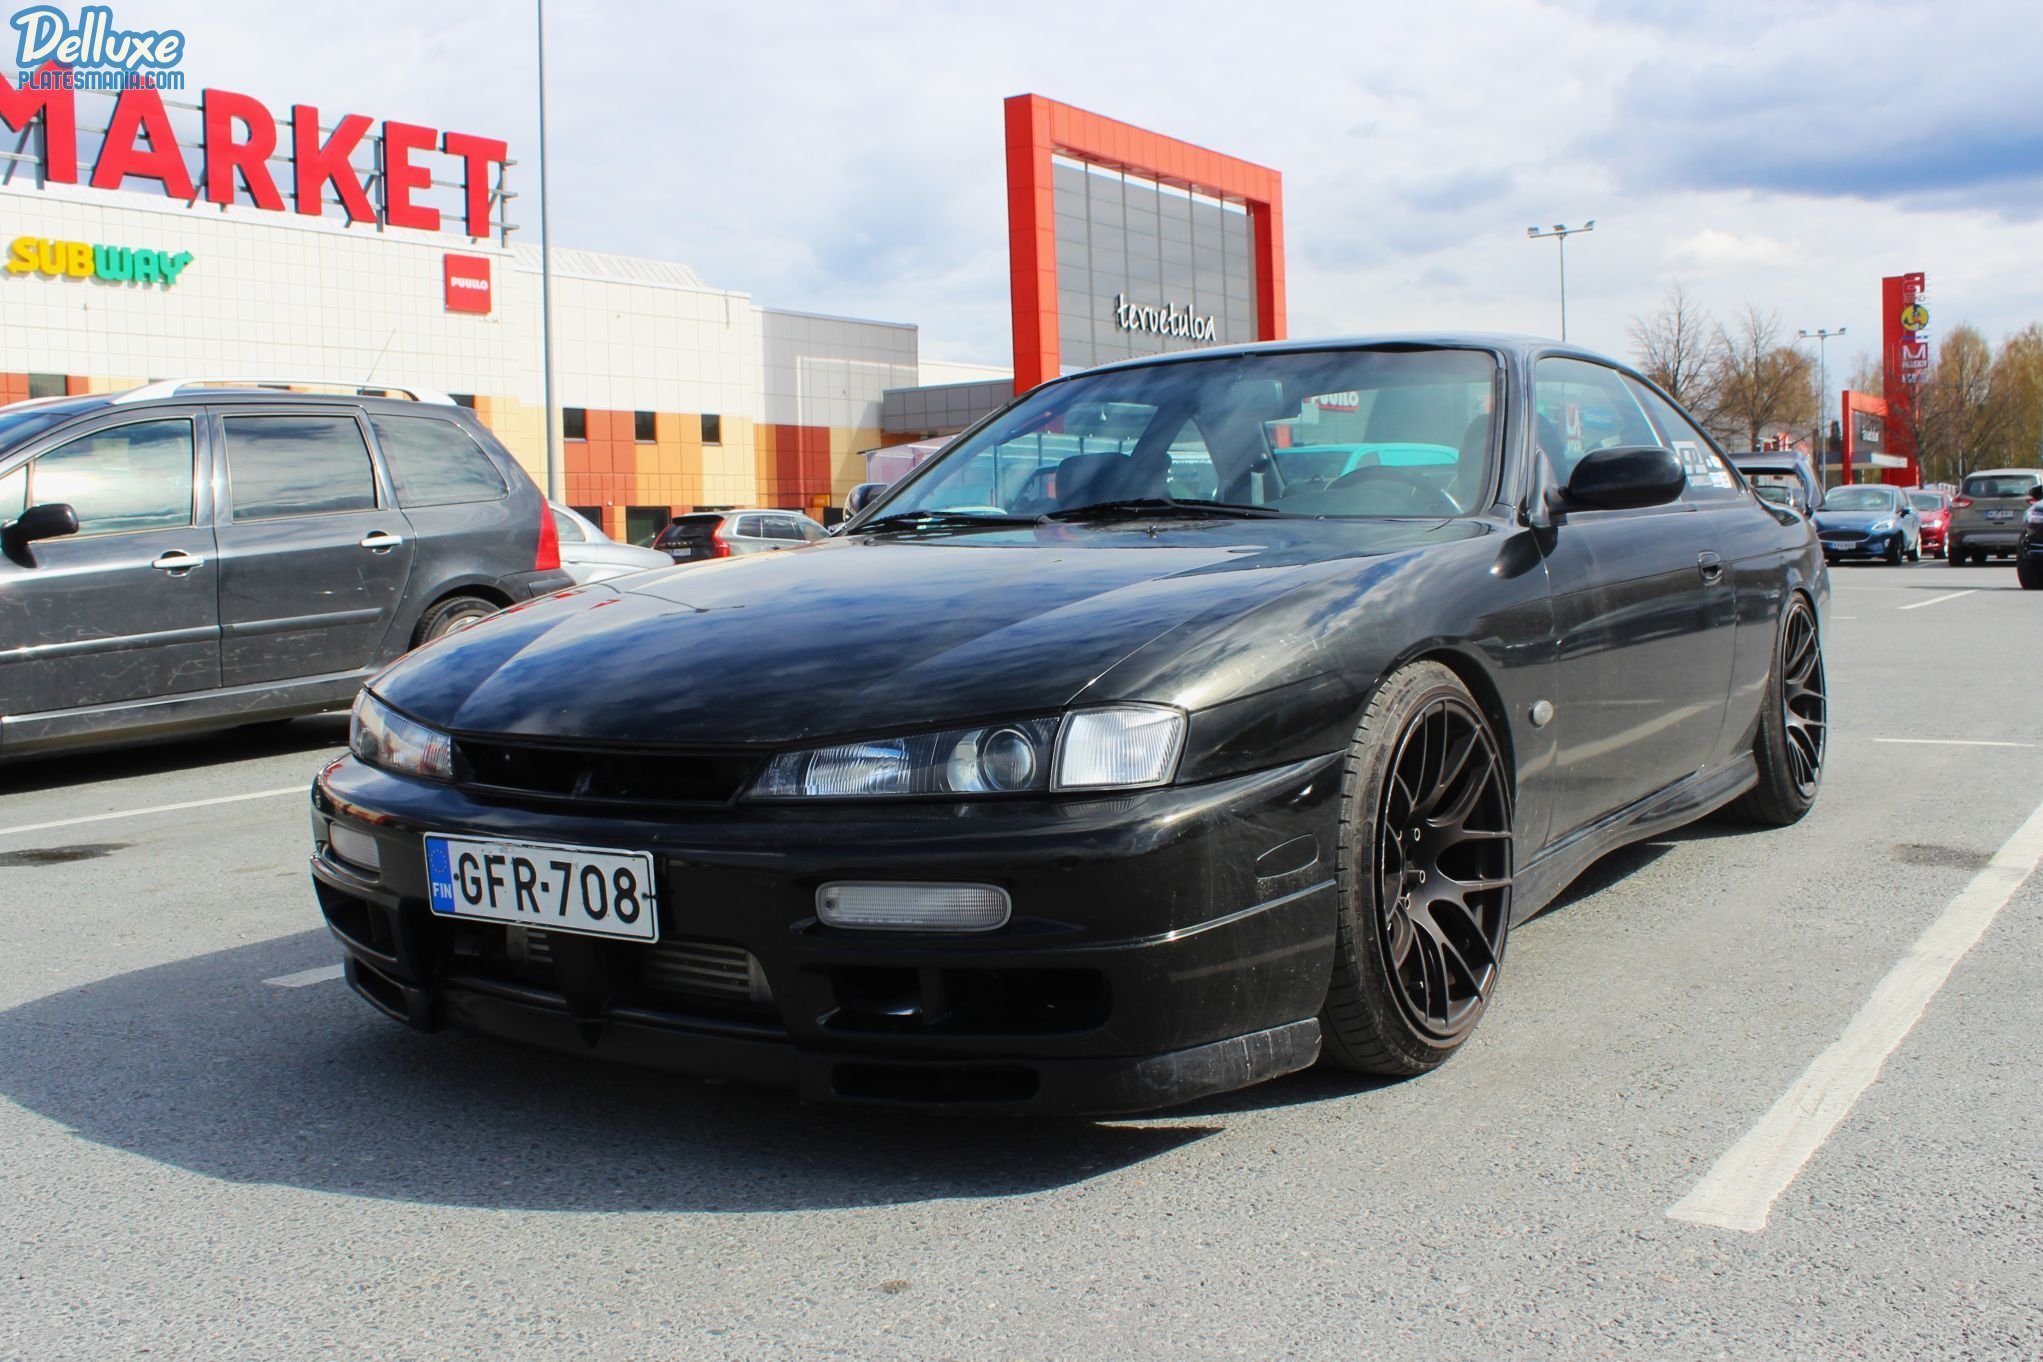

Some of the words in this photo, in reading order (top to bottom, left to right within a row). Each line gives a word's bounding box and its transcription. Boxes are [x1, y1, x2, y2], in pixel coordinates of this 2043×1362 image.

[0, 59, 508, 238] MARKET
[6, 236, 194, 285] SUBWAY
[450, 276, 489, 291] PUUILO
[1116, 292, 1217, 342] tervetuloa
[432, 881, 453, 900] FIN
[458, 851, 641, 925] GFR-708
